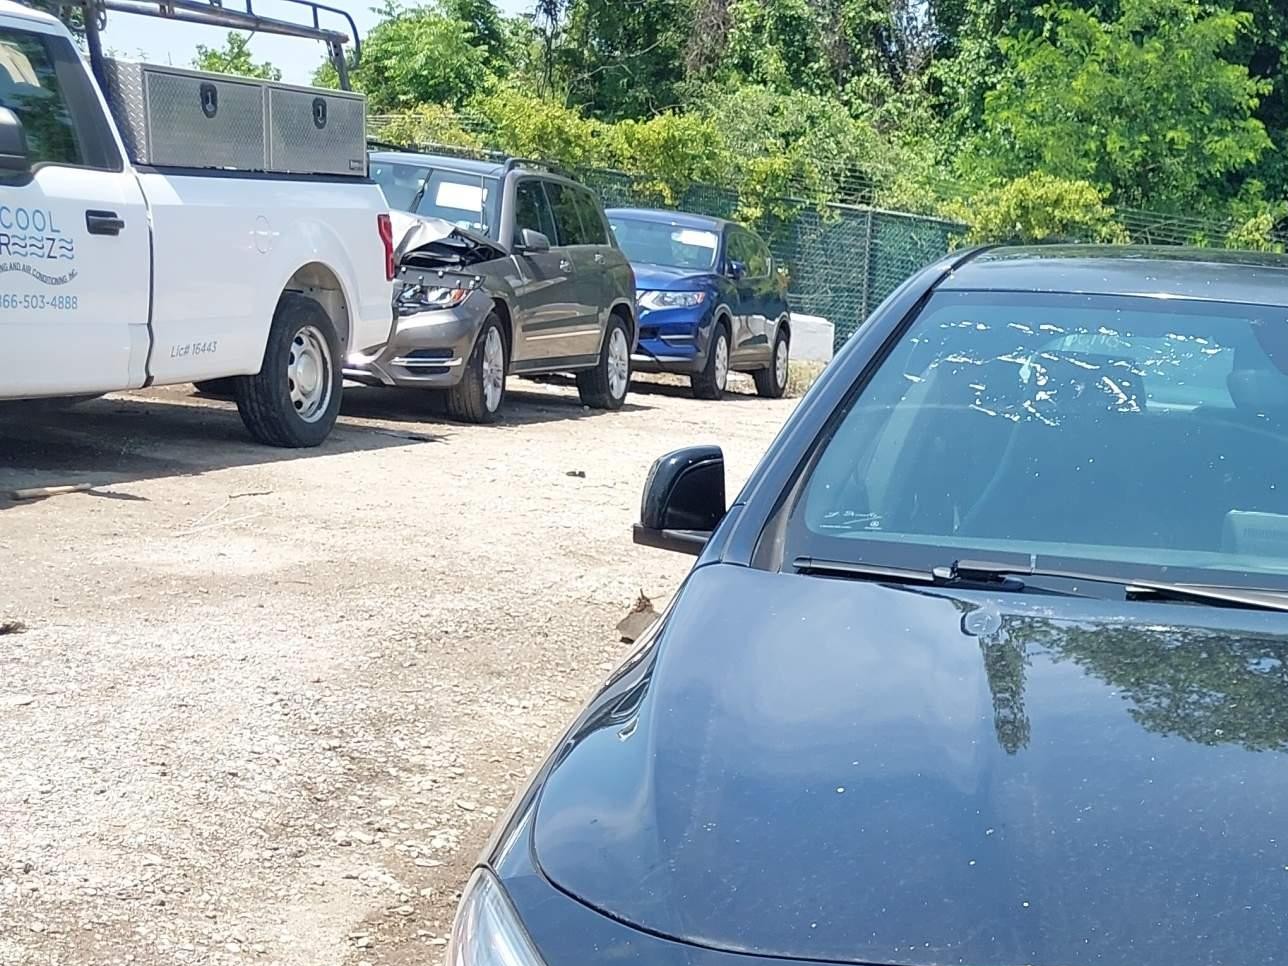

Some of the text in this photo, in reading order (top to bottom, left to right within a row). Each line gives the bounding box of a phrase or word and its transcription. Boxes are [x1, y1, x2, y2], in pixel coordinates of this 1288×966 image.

[0, 206, 61, 233] COOL
[9, 262, 21, 271] AND
[22, 263, 32, 274] AIR
[191, 341, 217, 356] 16443
